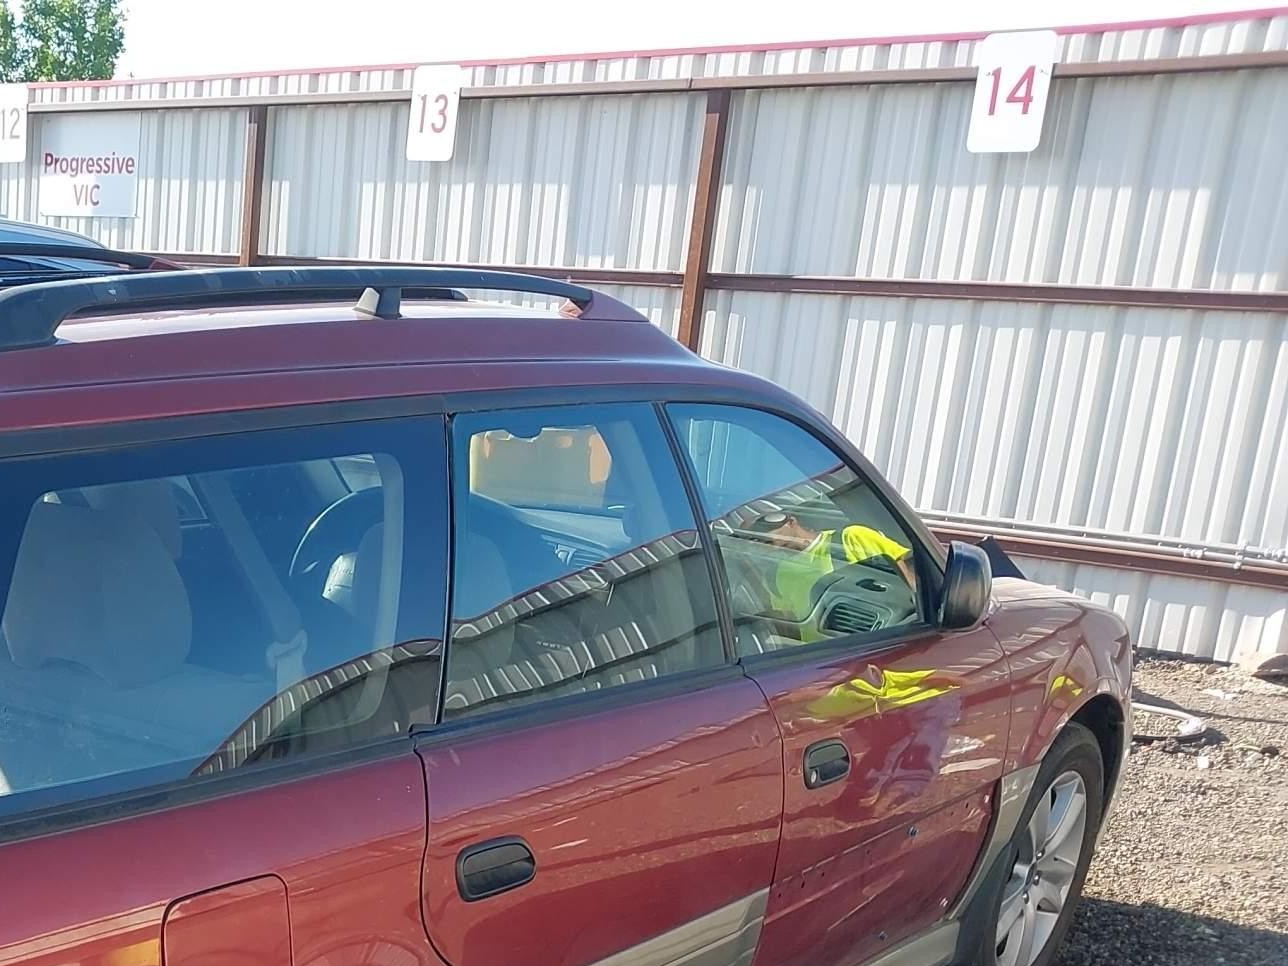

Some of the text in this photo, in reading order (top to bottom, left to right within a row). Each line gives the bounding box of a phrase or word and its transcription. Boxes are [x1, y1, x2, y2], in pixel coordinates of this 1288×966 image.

[987, 64, 1036, 116] 14
[1, 107, 21, 140] 12
[418, 93, 449, 134] 13
[43, 151, 136, 178] Progressive
[72, 183, 101, 207] VIC
